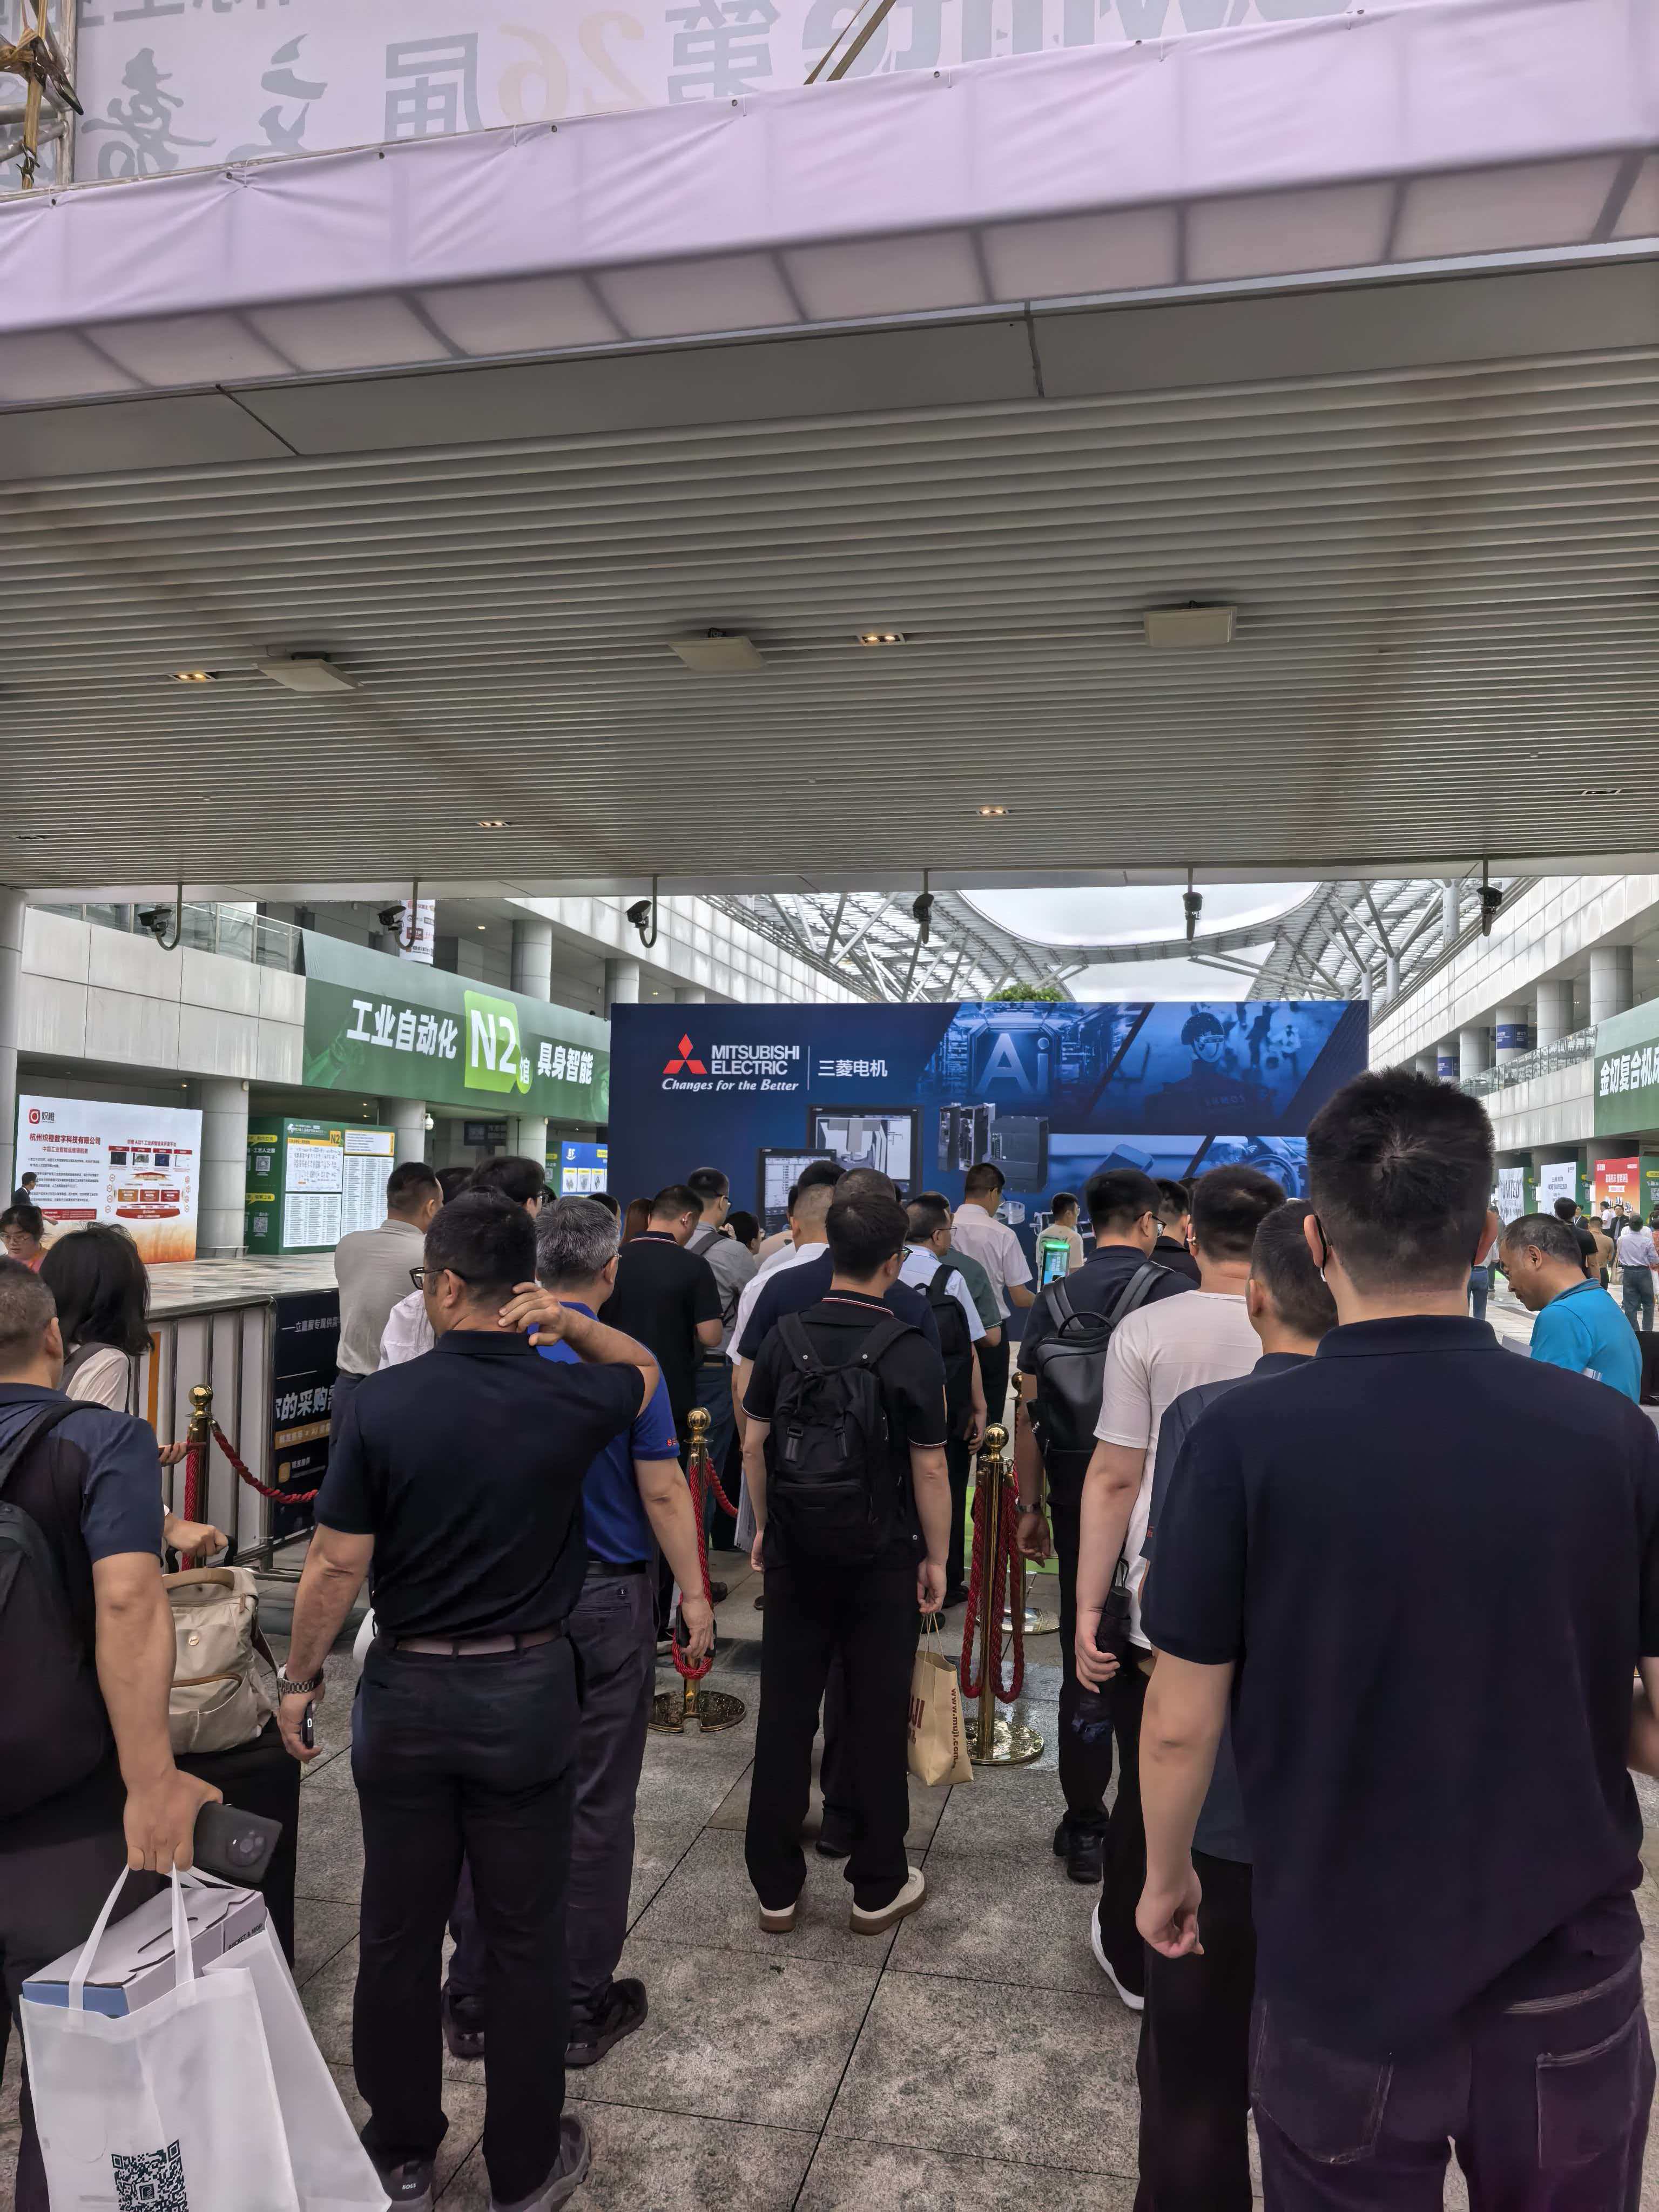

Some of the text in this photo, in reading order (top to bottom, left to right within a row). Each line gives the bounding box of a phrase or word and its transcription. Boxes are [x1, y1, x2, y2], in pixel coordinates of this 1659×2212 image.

[346, 999, 458, 1059] 工业自动化
[538, 1042, 594, 1084] 具身智能
[711, 1045, 800, 1060] MITSUBISHI
[711, 1060, 788, 1075] ELECTRIC
[818, 1059, 888, 1077] 三菱电机
[662, 1078, 799, 1092] Changes for the Better
